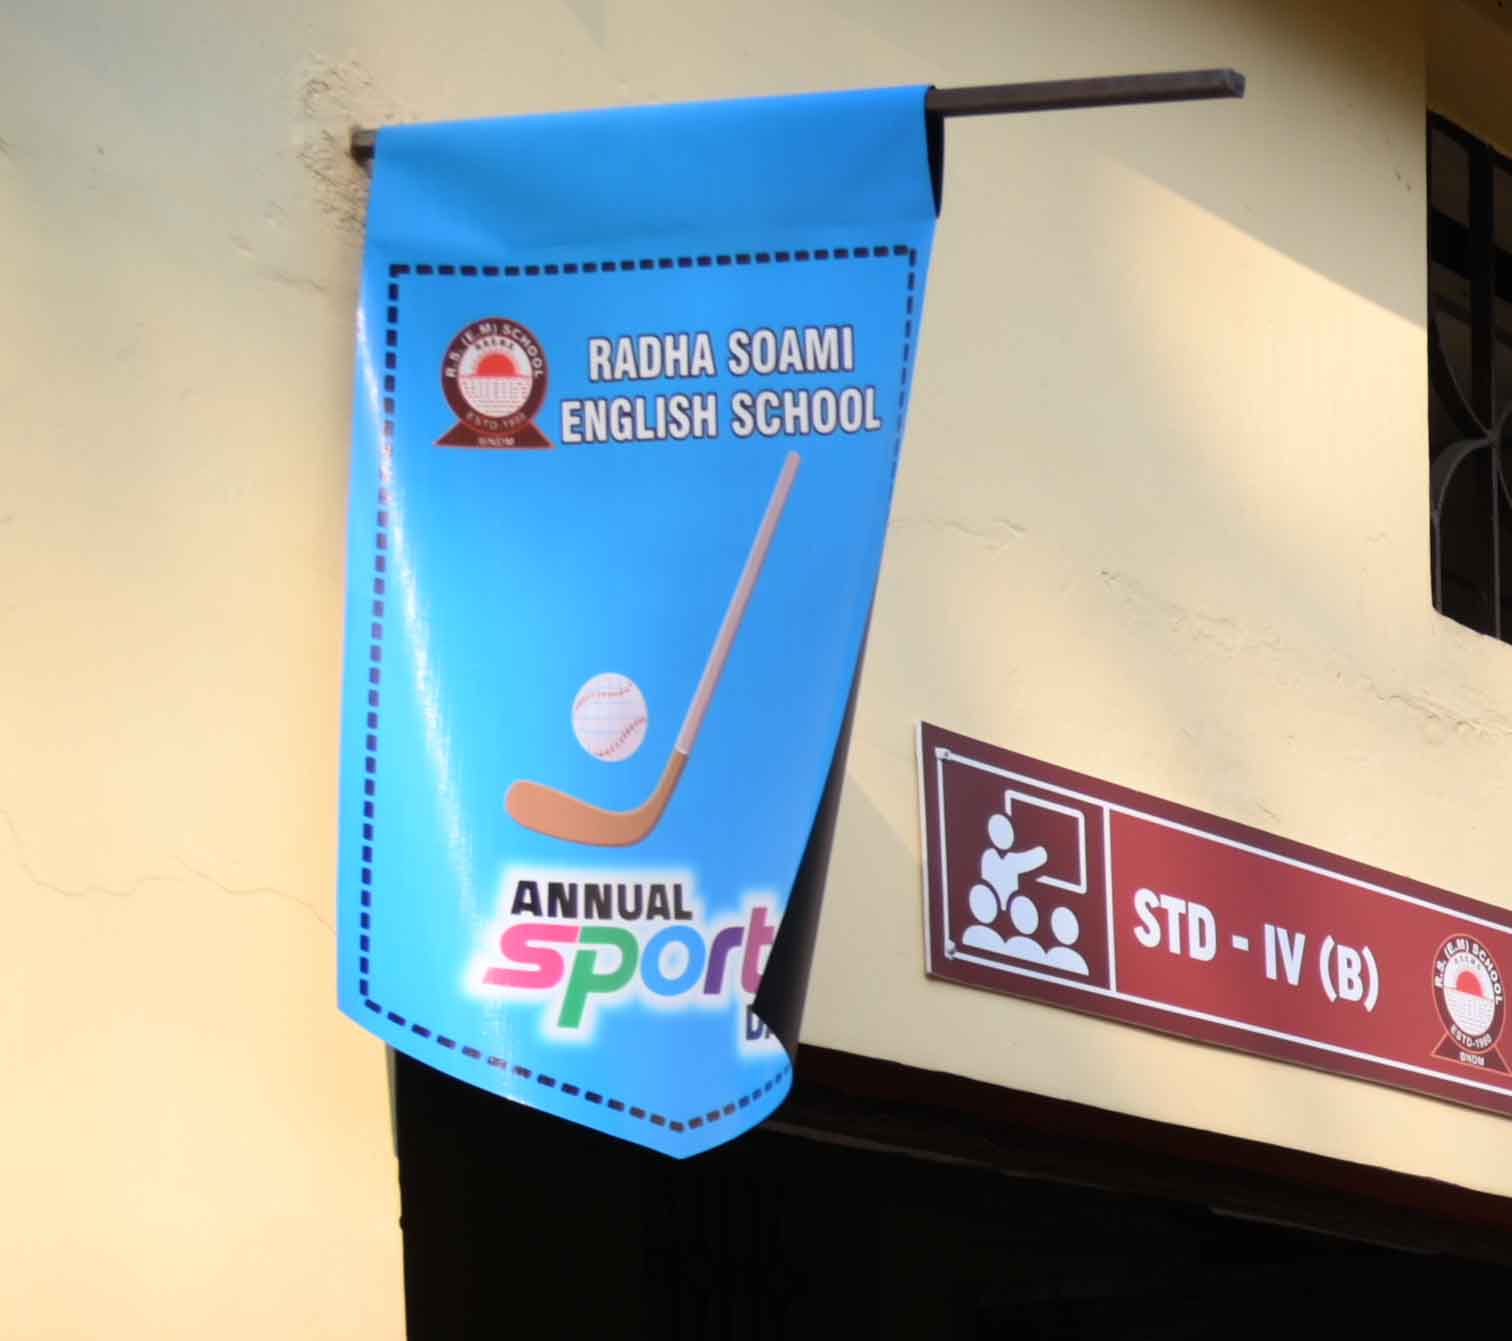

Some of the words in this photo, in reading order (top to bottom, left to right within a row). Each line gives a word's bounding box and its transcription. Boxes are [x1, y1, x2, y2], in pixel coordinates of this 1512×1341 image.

[588, 332, 716, 382] RADHA
[727, 324, 855, 374] SOAMI
[560, 394, 717, 445] ENGLISH
[731, 386, 882, 437] SCHOOL
[510, 880, 693, 921] ANNUAL
[481, 906, 775, 1029] sport
[1133, 886, 1217, 962] STD
[1231, 934, 1250, 953] -
[1263, 922, 1306, 987] IV
[1318, 934, 1380, 1014] (B)
[1471, 943, 1504, 1006] SCHOOL
